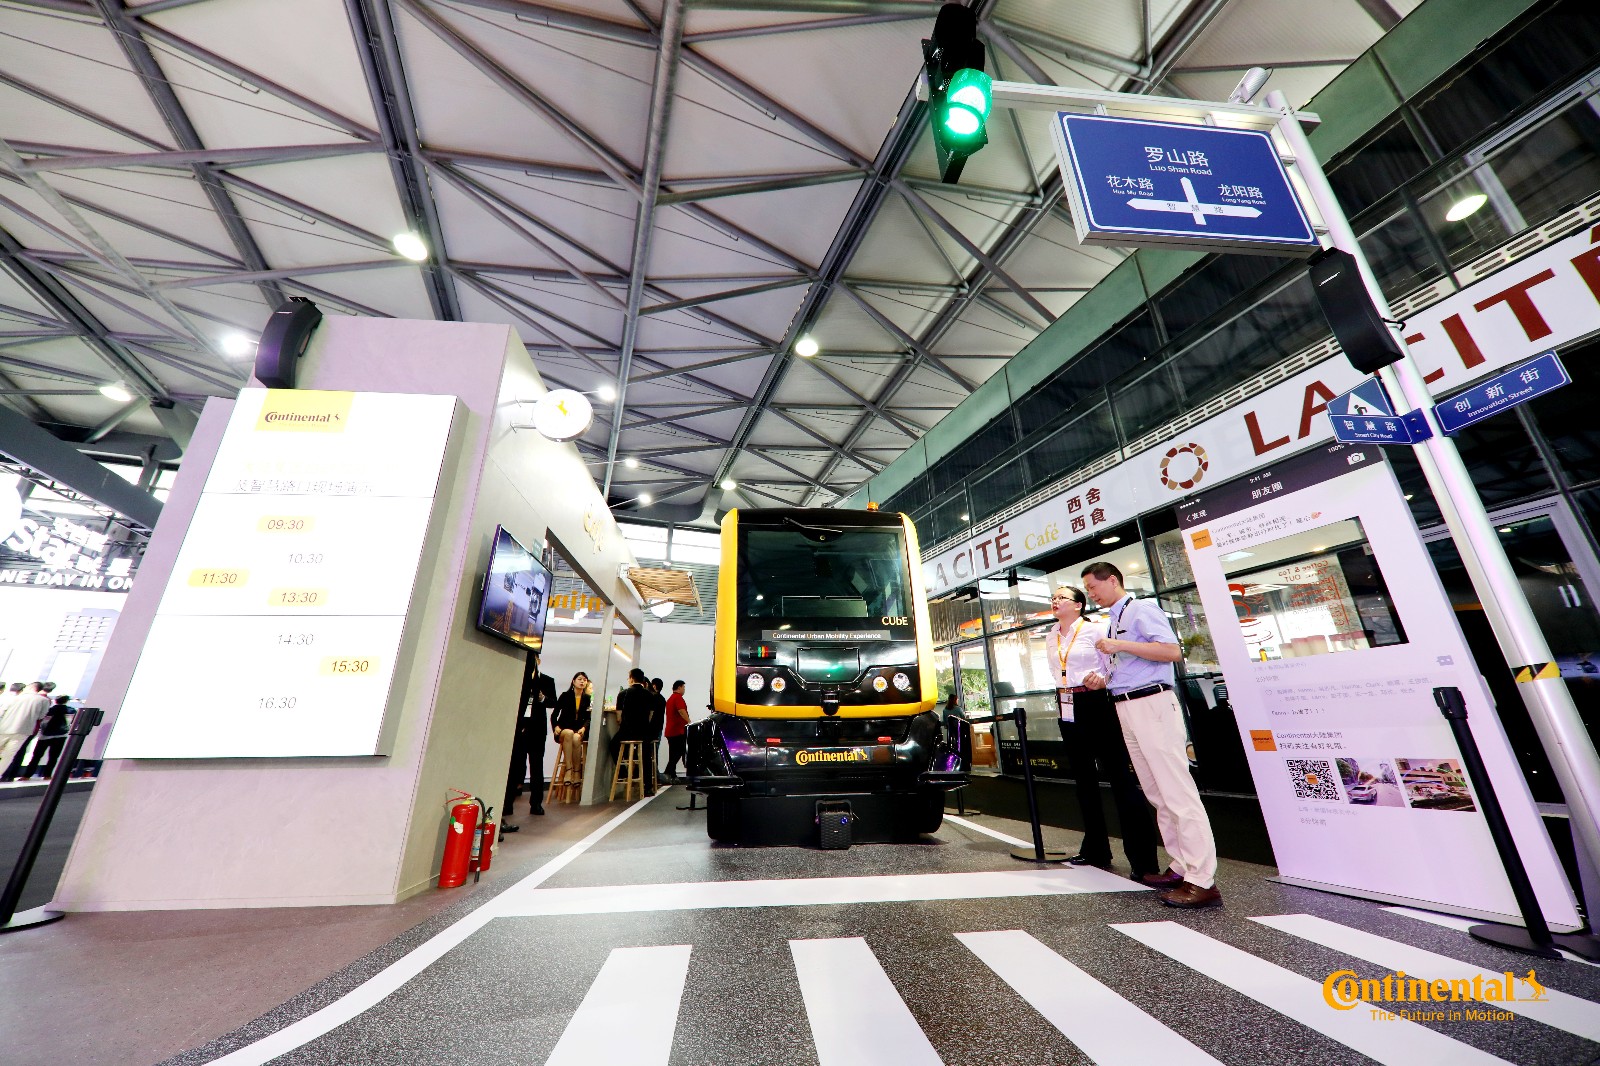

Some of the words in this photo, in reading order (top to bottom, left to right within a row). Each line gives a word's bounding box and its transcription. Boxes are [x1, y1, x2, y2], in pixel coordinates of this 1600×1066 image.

[1144, 146, 1209, 167] 罗山路
[1150, 164, 1167, 172] Luo
[1167, 166, 1189, 175] Shan
[1190, 167, 1213, 176] Road
[1106, 174, 1154, 190] 花木路
[1217, 183, 1263, 199] 龙阳路
[1454, 367, 1540, 413] 创新街
[1467, 396, 1509, 418] Innovation
[1508, 386, 1535, 399] Street
[265, 411, 332, 423] Continental
[1243, 379, 1338, 457] LA
[1343, 419, 1397, 431] 智慧路
[1066, 487, 1101, 515] 西舍
[267, 519, 305, 530] 09:30
[1070, 507, 1107, 534] 西食
[952, 525, 1013, 579] CITÉ
[1024, 522, 1060, 551] Café
[34, 571, 78, 587] DAY
[80, 574, 104, 588] IN
[202, 572, 238, 584] 11:30
[281, 592, 318, 603] 13:30
[278, 633, 314, 645] 14:30
[825, 633, 849, 641] Mobility
[849, 632, 882, 641] Experience
[331, 660, 369, 673] 15:30
[795, 749, 859, 766] Continental
